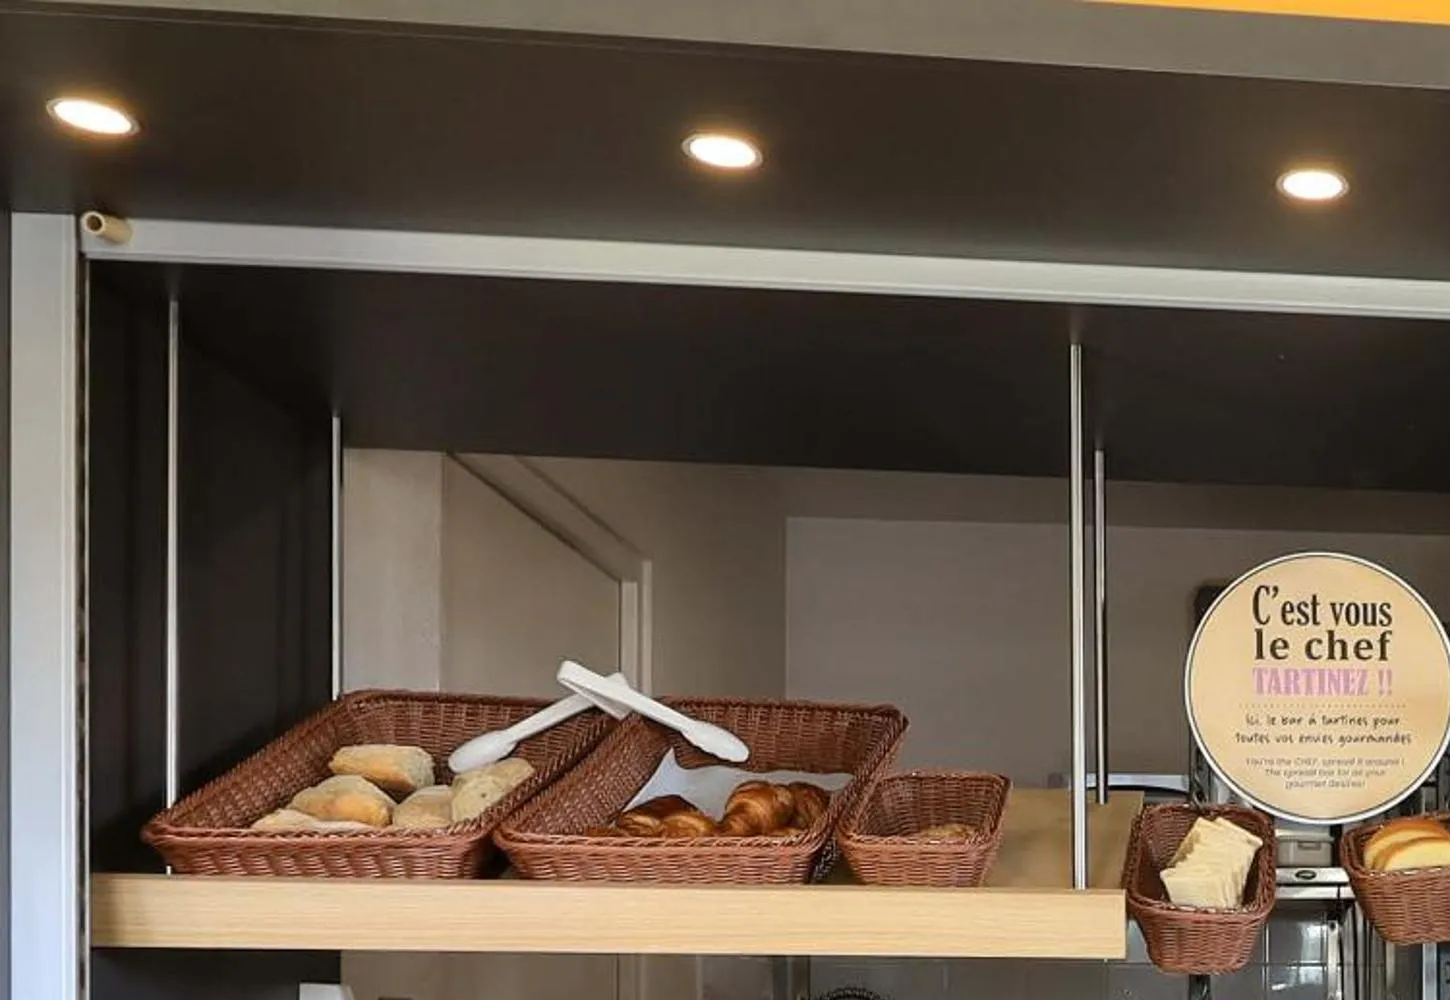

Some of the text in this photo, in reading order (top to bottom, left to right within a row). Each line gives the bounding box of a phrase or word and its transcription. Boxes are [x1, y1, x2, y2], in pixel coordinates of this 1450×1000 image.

[1252, 584, 1393, 628] C'est vous
[1254, 628, 1393, 662] le chef
[1252, 667, 1369, 696] TARTINEZ
[1321, 713, 1368, 727] tartines
[1373, 716, 1400, 729] pour
[1234, 731, 1271, 744] toutes
[1299, 733, 1334, 745] envies
[1337, 733, 1412, 748] gourmandes
